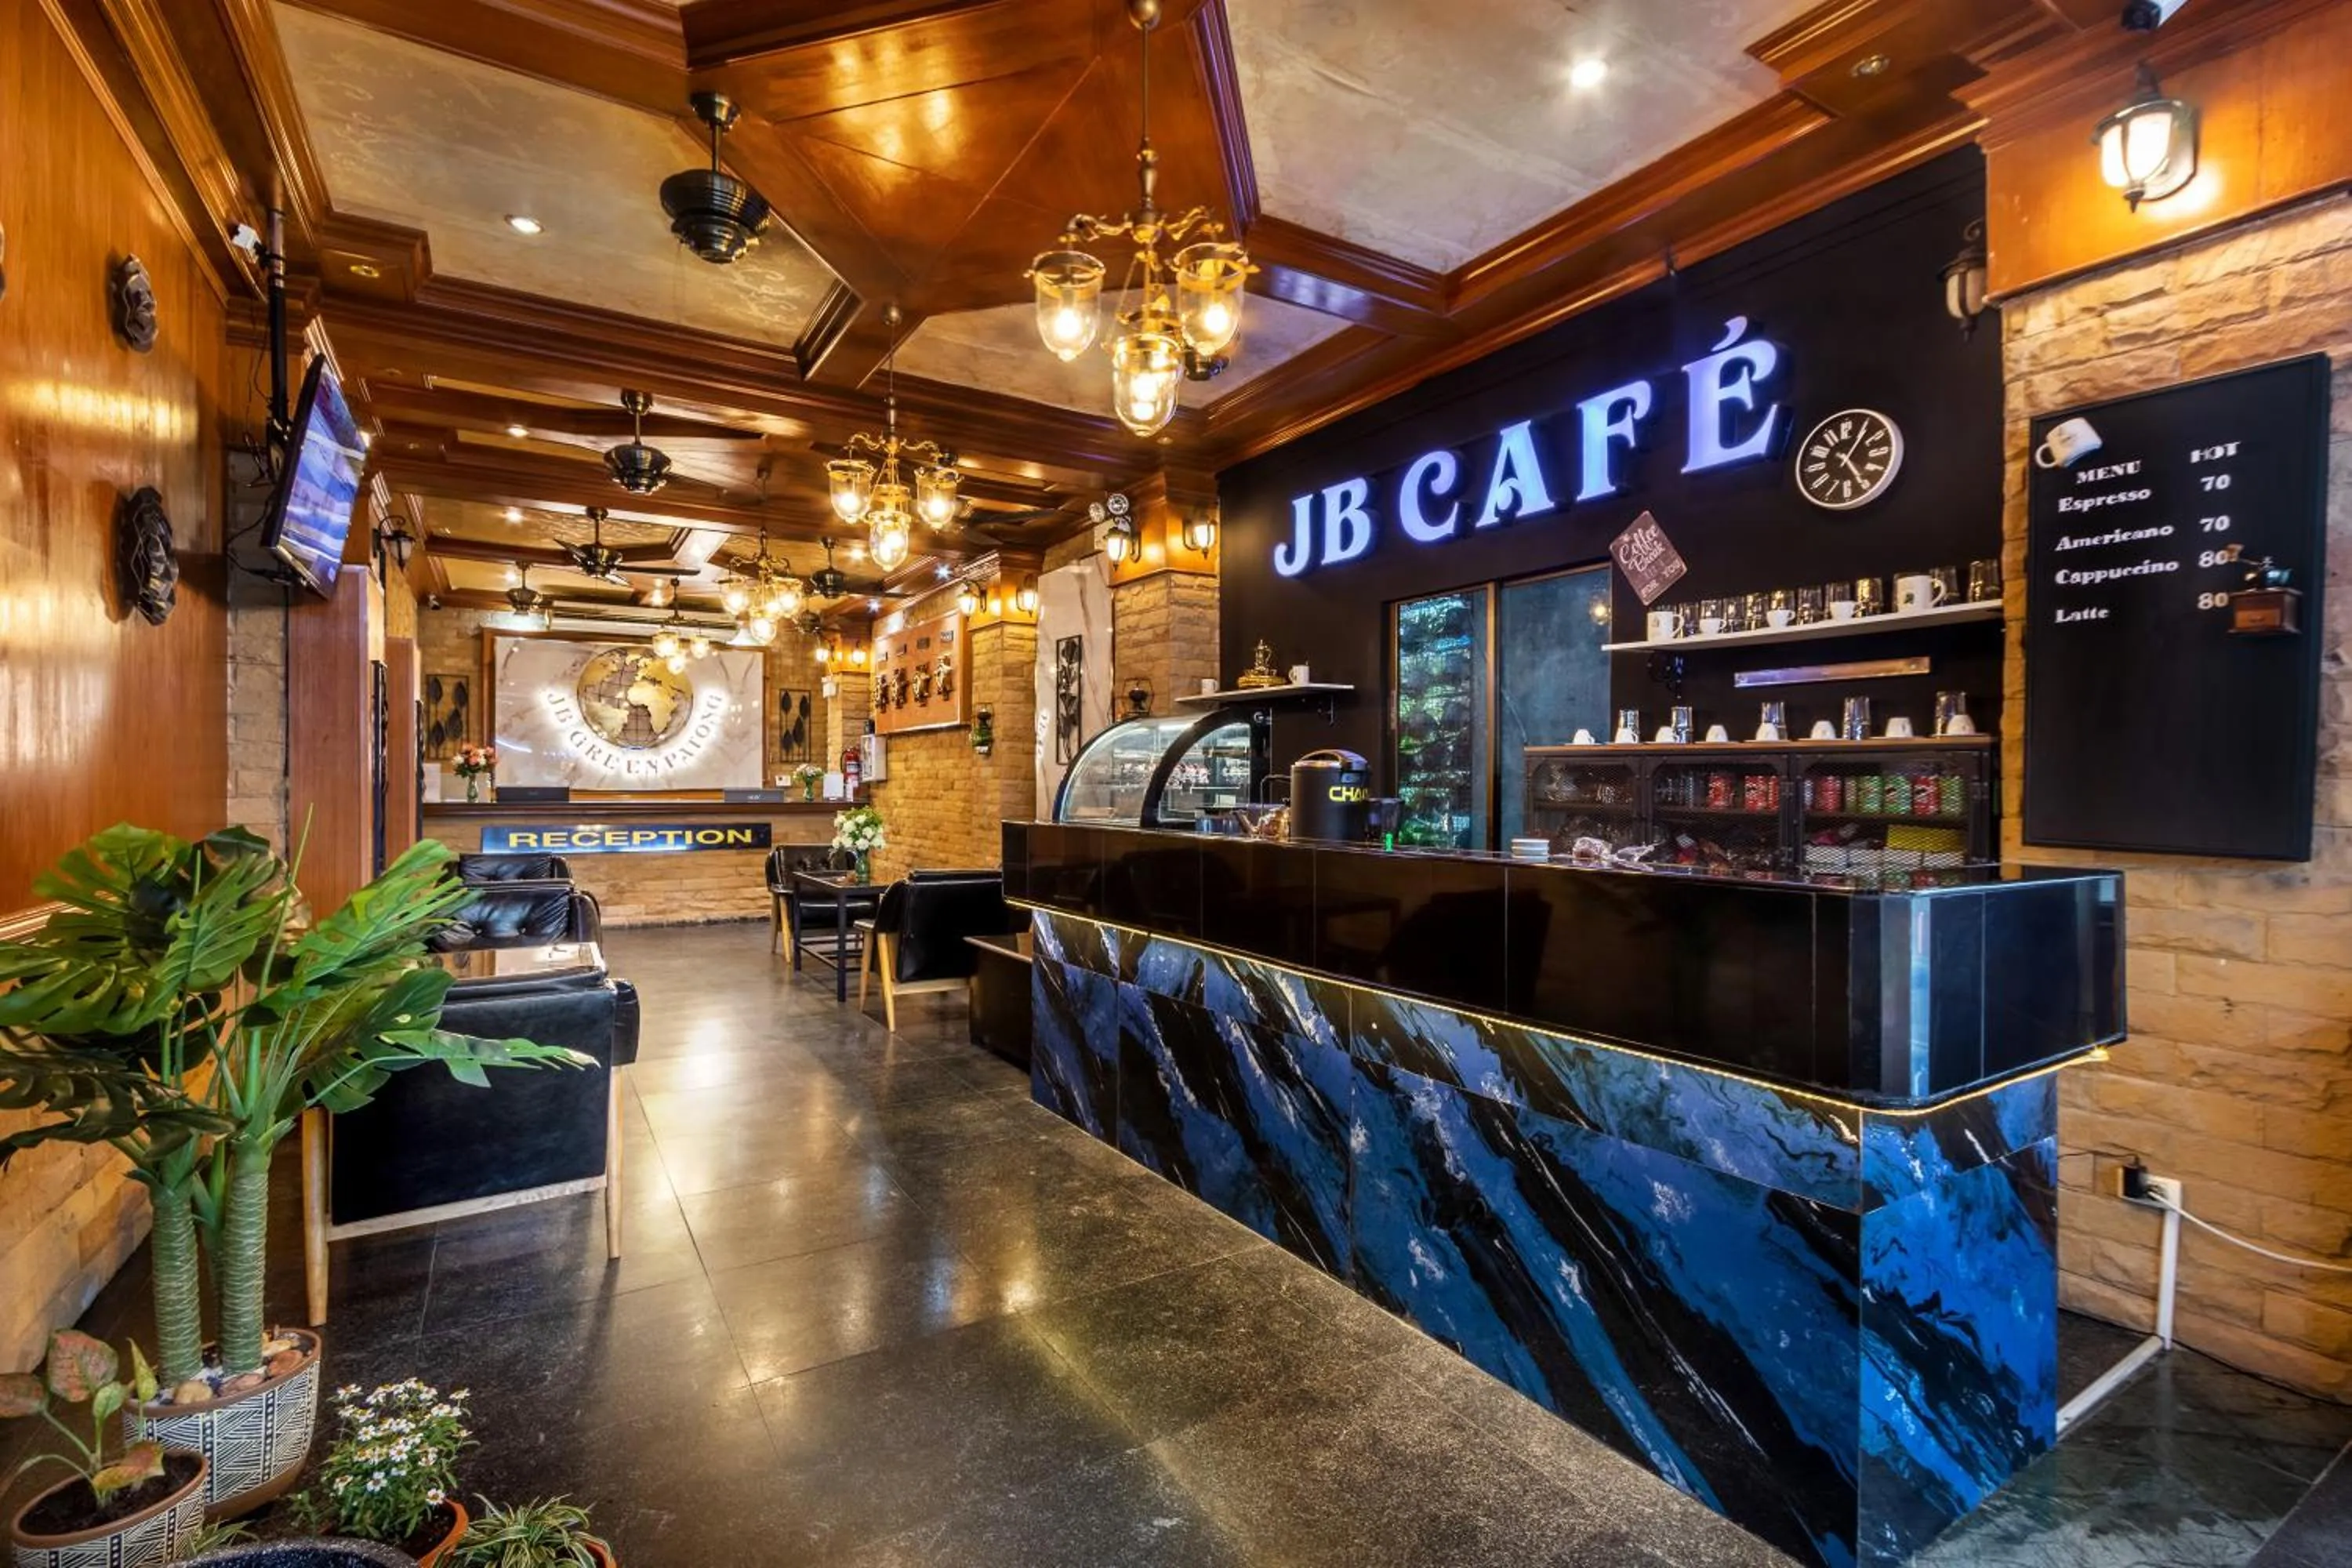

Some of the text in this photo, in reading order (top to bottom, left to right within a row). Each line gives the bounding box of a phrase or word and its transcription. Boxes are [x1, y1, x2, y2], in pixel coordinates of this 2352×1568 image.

[1273, 315, 1777, 578] JB CAFÉ
[2076, 441, 2241, 484] MENU HOT
[2057, 474, 2231, 513] Espresso 70
[2054, 514, 2230, 551] Americano 70
[2054, 550, 2228, 585] Cappuccino 80
[2054, 592, 2229, 623] Latte 80
[509, 828, 753, 848] RECEPTION
